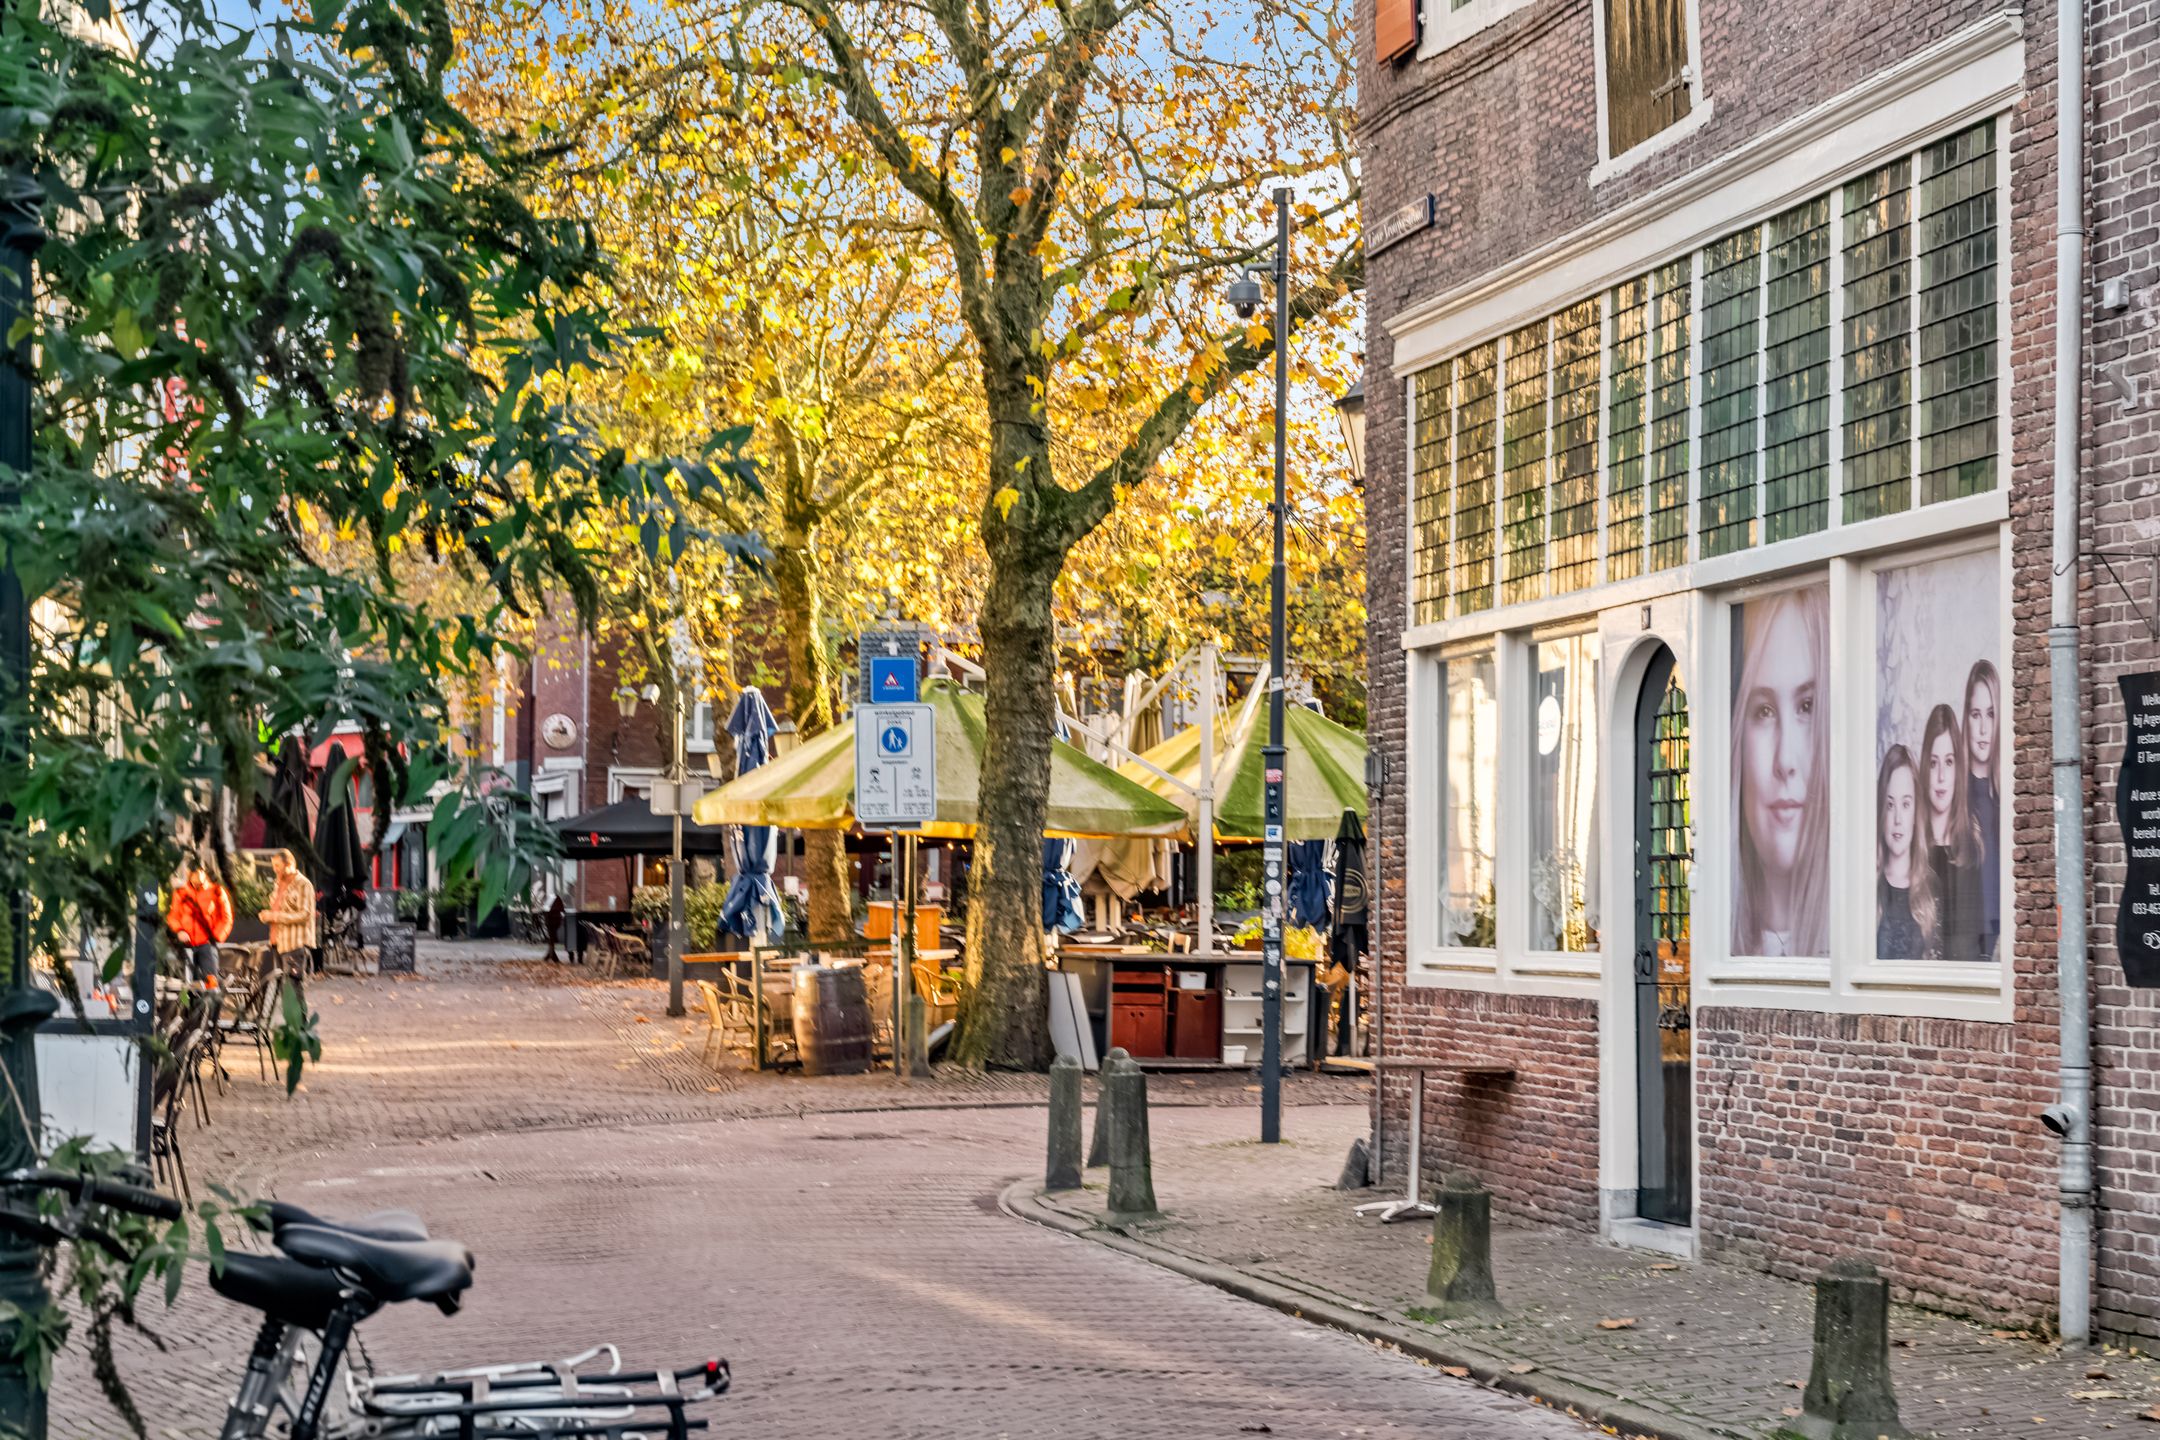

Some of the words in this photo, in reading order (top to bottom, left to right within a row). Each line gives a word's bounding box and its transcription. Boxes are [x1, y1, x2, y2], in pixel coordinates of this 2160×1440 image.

[2133, 714, 2143, 728] bij
[2137, 751, 2145, 763] El
[2130, 789, 2139, 801] Al
[2139, 791, 2157, 801] onze
[2133, 826, 2156, 839] bereid
